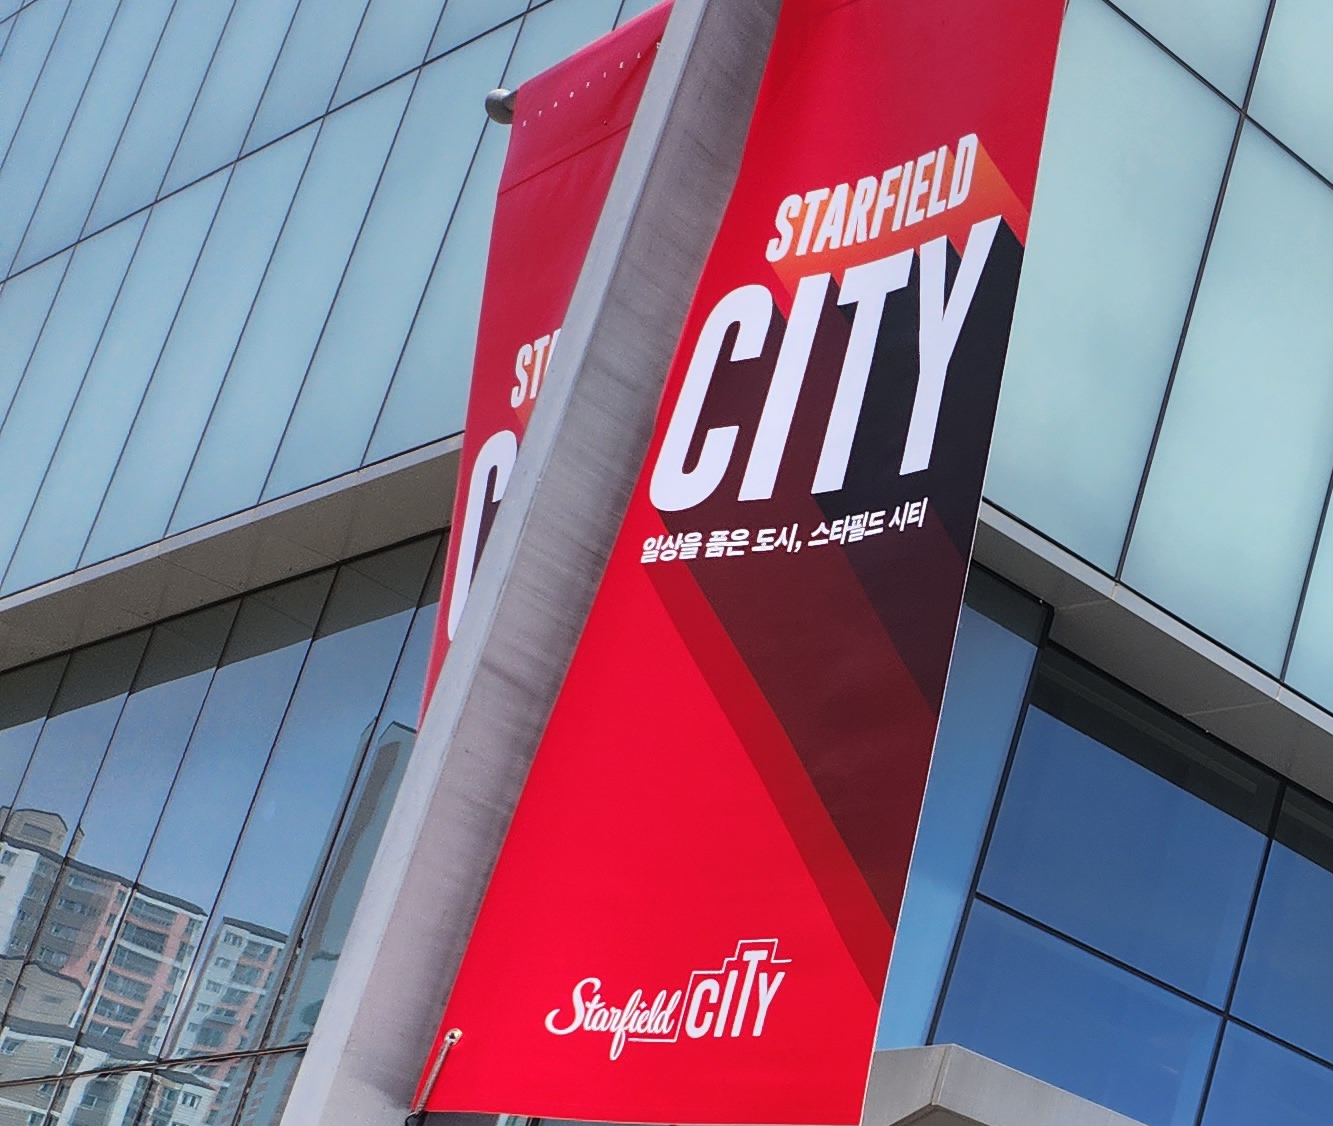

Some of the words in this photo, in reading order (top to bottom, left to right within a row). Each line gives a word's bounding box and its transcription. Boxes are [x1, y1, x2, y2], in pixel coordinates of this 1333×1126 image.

[765, 133, 977, 262] STARFIELD
[649, 215, 1002, 512] CITY
[641, 532, 702, 563] 일상을
[705, 529, 749, 558] 품은
[752, 523, 802, 553] 도시,
[808, 510, 886, 545] 스타필드
[888, 497, 929, 531] 시티
[545, 977, 682, 1060] Starfield
[685, 950, 785, 1038] CITY
